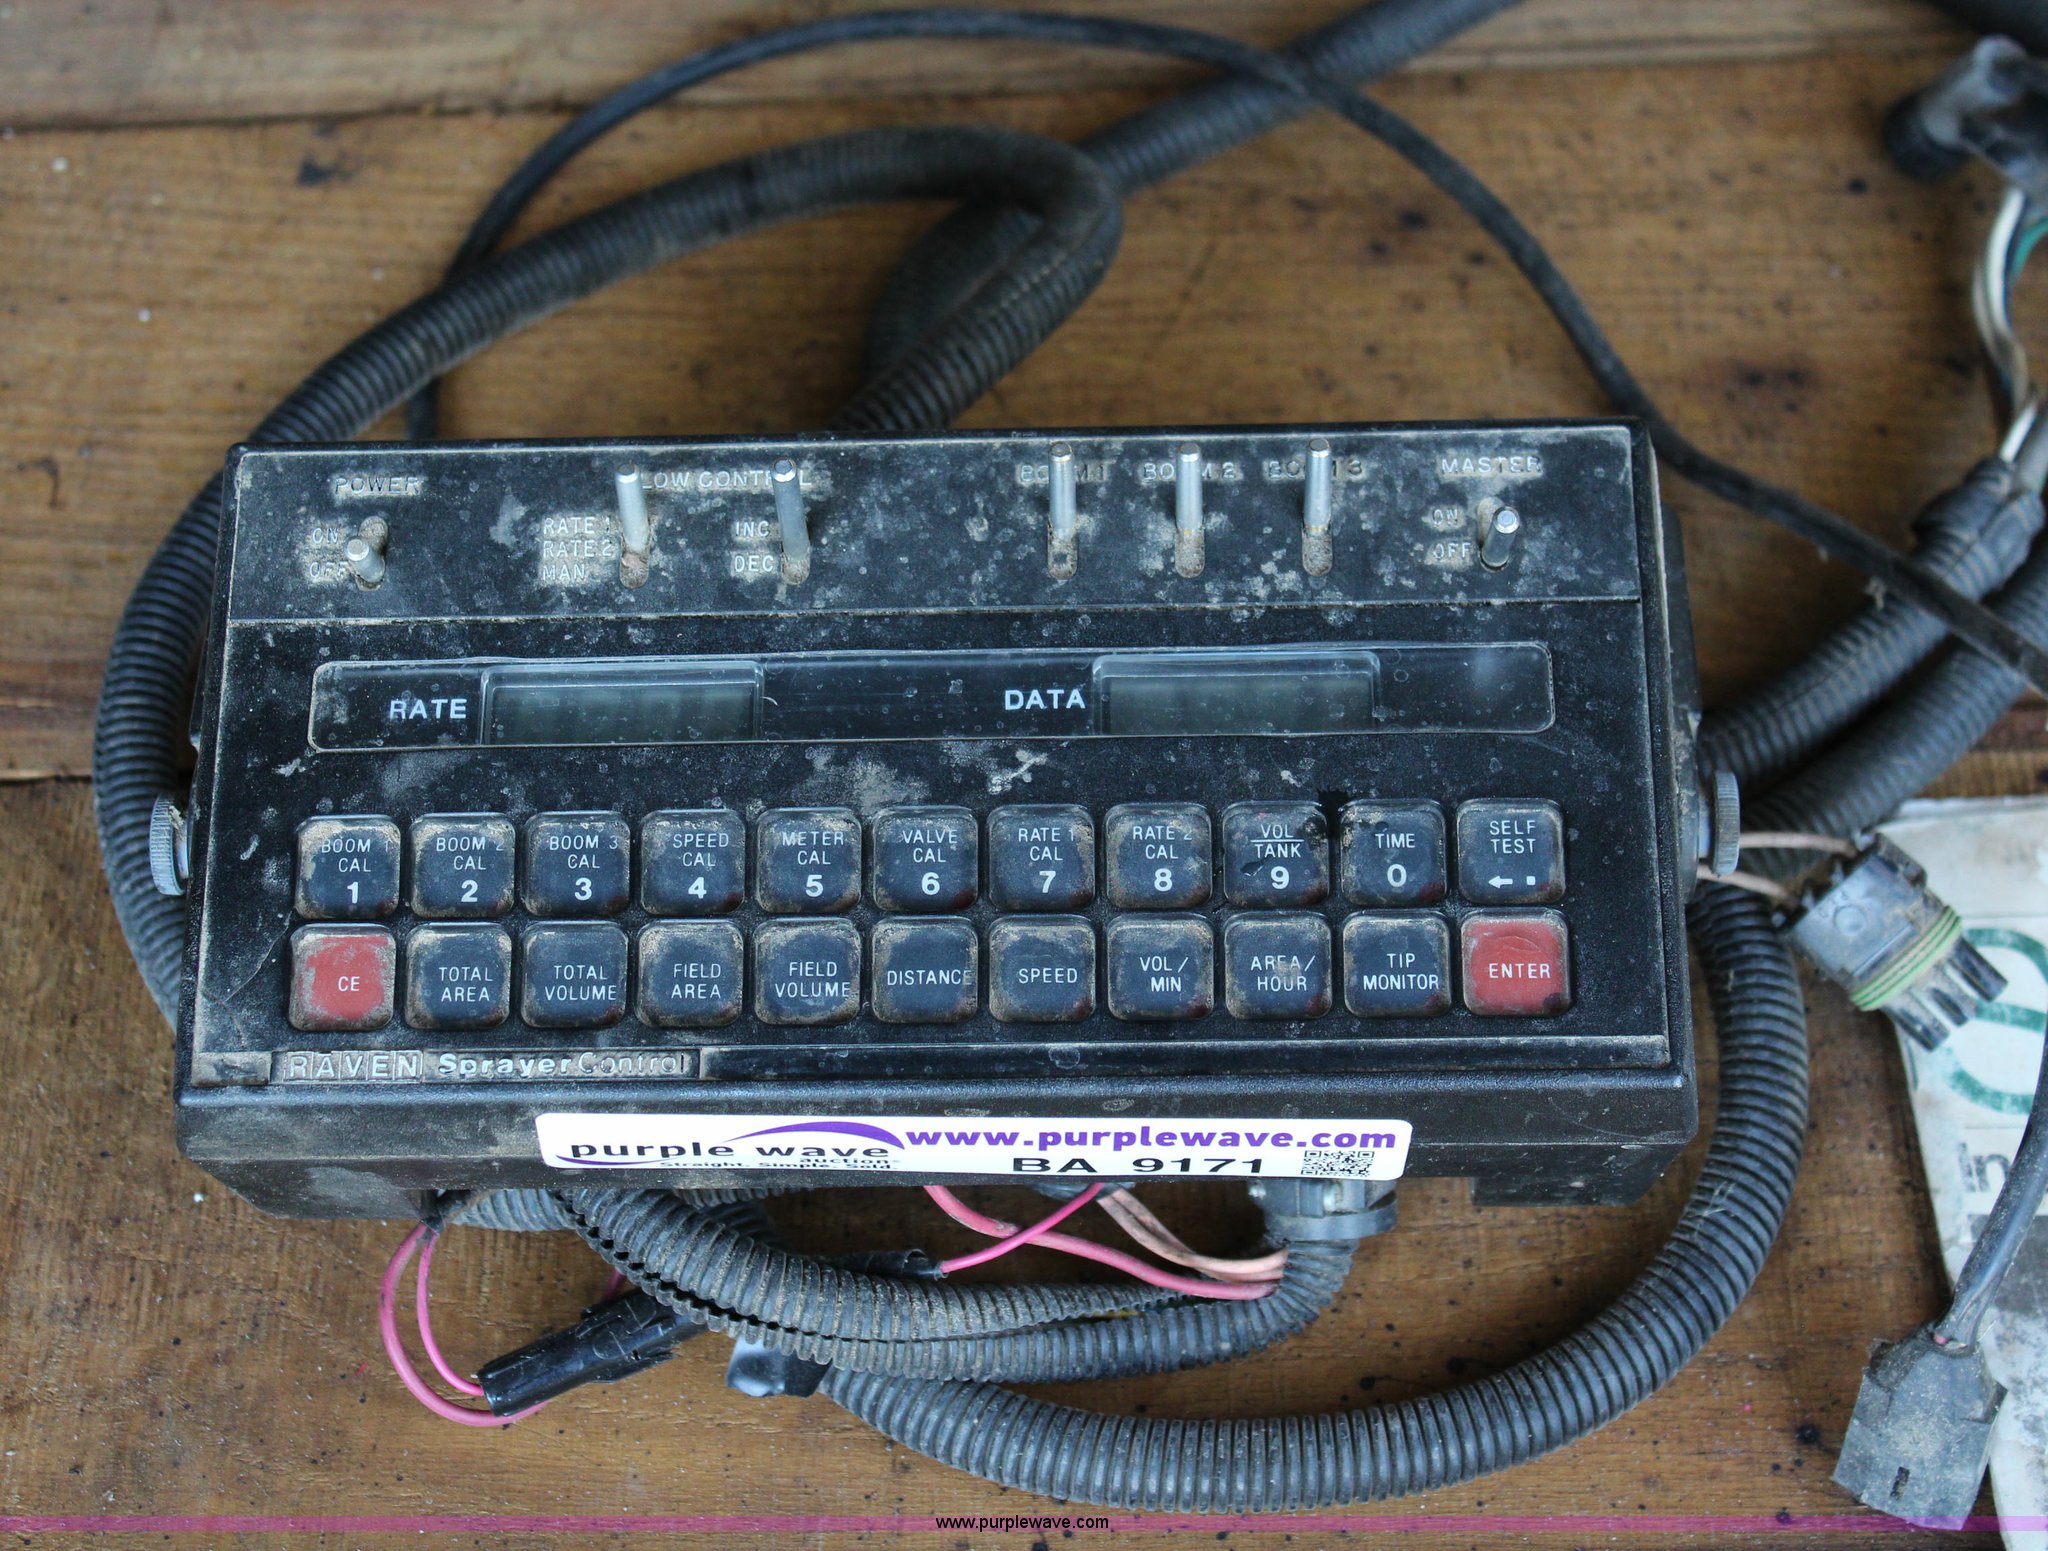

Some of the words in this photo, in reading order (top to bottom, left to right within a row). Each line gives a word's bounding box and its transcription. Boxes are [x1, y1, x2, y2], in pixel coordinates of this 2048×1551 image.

[1222, 463, 1236, 480] 2
[1348, 461, 1363, 478] 3
[1440, 456, 1541, 473] MASTER
[638, 471, 691, 490] LOW
[698, 470, 812, 488] CONTL
[1020, 464, 1089, 482] BOM
[334, 476, 420, 495] POWER
[1432, 508, 1459, 526] ON
[543, 517, 596, 535] RATE
[735, 521, 770, 537] INC
[312, 527, 339, 544] ON
[542, 540, 596, 558] RATE
[601, 540, 613, 557] 2
[1432, 541, 1471, 560] OFF
[309, 560, 350, 579] OFF
[541, 563, 587, 581] MAN
[734, 555, 775, 573] DEC
[1004, 688, 1086, 710] DATA
[388, 698, 468, 721] RATE
[1018, 827, 1061, 843] RATE
[1132, 825, 1176, 841] RATE
[1260, 824, 1294, 839] VOL
[1489, 820, 1537, 836] SELF
[435, 837, 487, 852] BOOM
[549, 835, 600, 851] BOOM
[608, 835, 619, 850] 3
[672, 833, 730, 849] SPEED
[781, 831, 845, 847] METER
[902, 829, 958, 845] VALVE
[1375, 833, 1416, 849] TIME
[321, 838, 372, 854] BOOM
[1029, 846, 1063, 861] CAL
[1145, 844, 1179, 860] CAL
[1253, 843, 1302, 859] TANK
[1489, 838, 1537, 854] TEST
[453, 855, 487, 871] CAL
[567, 854, 601, 869] CAL
[682, 852, 716, 867] CAL
[797, 850, 831, 866] CAL
[912, 848, 947, 864] CAL
[338, 858, 372, 873] CAL
[1038, 870, 1057, 894] 7
[1153, 867, 1173, 892] 8
[1270, 865, 1290, 890] 9
[1386, 863, 1408, 888] 0
[460, 879, 479, 903] 2
[574, 877, 593, 902] 3
[687, 876, 708, 900] 4
[804, 874, 824, 898] 5
[920, 872, 941, 896] 6
[347, 881, 360, 904] 1
[788, 961, 838, 977] FIELD
[1386, 953, 1416, 969] TIP
[438, 966, 494, 982] TOTAL
[553, 965, 608, 981] TOTAL
[673, 963, 722, 979] FIELD
[886, 969, 973, 986] DISTANCE
[1018, 968, 1078, 984] SPEED
[1488, 963, 1551, 979] ENTER
[337, 976, 361, 992] CE
[774, 982, 850, 998] VOLUME
[1150, 977, 1182, 992] MIN
[1257, 976, 1308, 992] HOUR
[1363, 974, 1440, 990] MONITOR
[440, 986, 490, 1002] AREA
[544, 984, 618, 1001] VOLUME
[670, 983, 722, 999] AREA
[286, 1050, 420, 1079] RAVEN
[905, 1124, 1397, 1152] www.purplewave.com
[570, 1141, 735, 1159] purple
[755, 1145, 890, 1159] wave
[1012, 1156, 1099, 1174] BA
[1132, 1158, 1263, 1175] 9171
